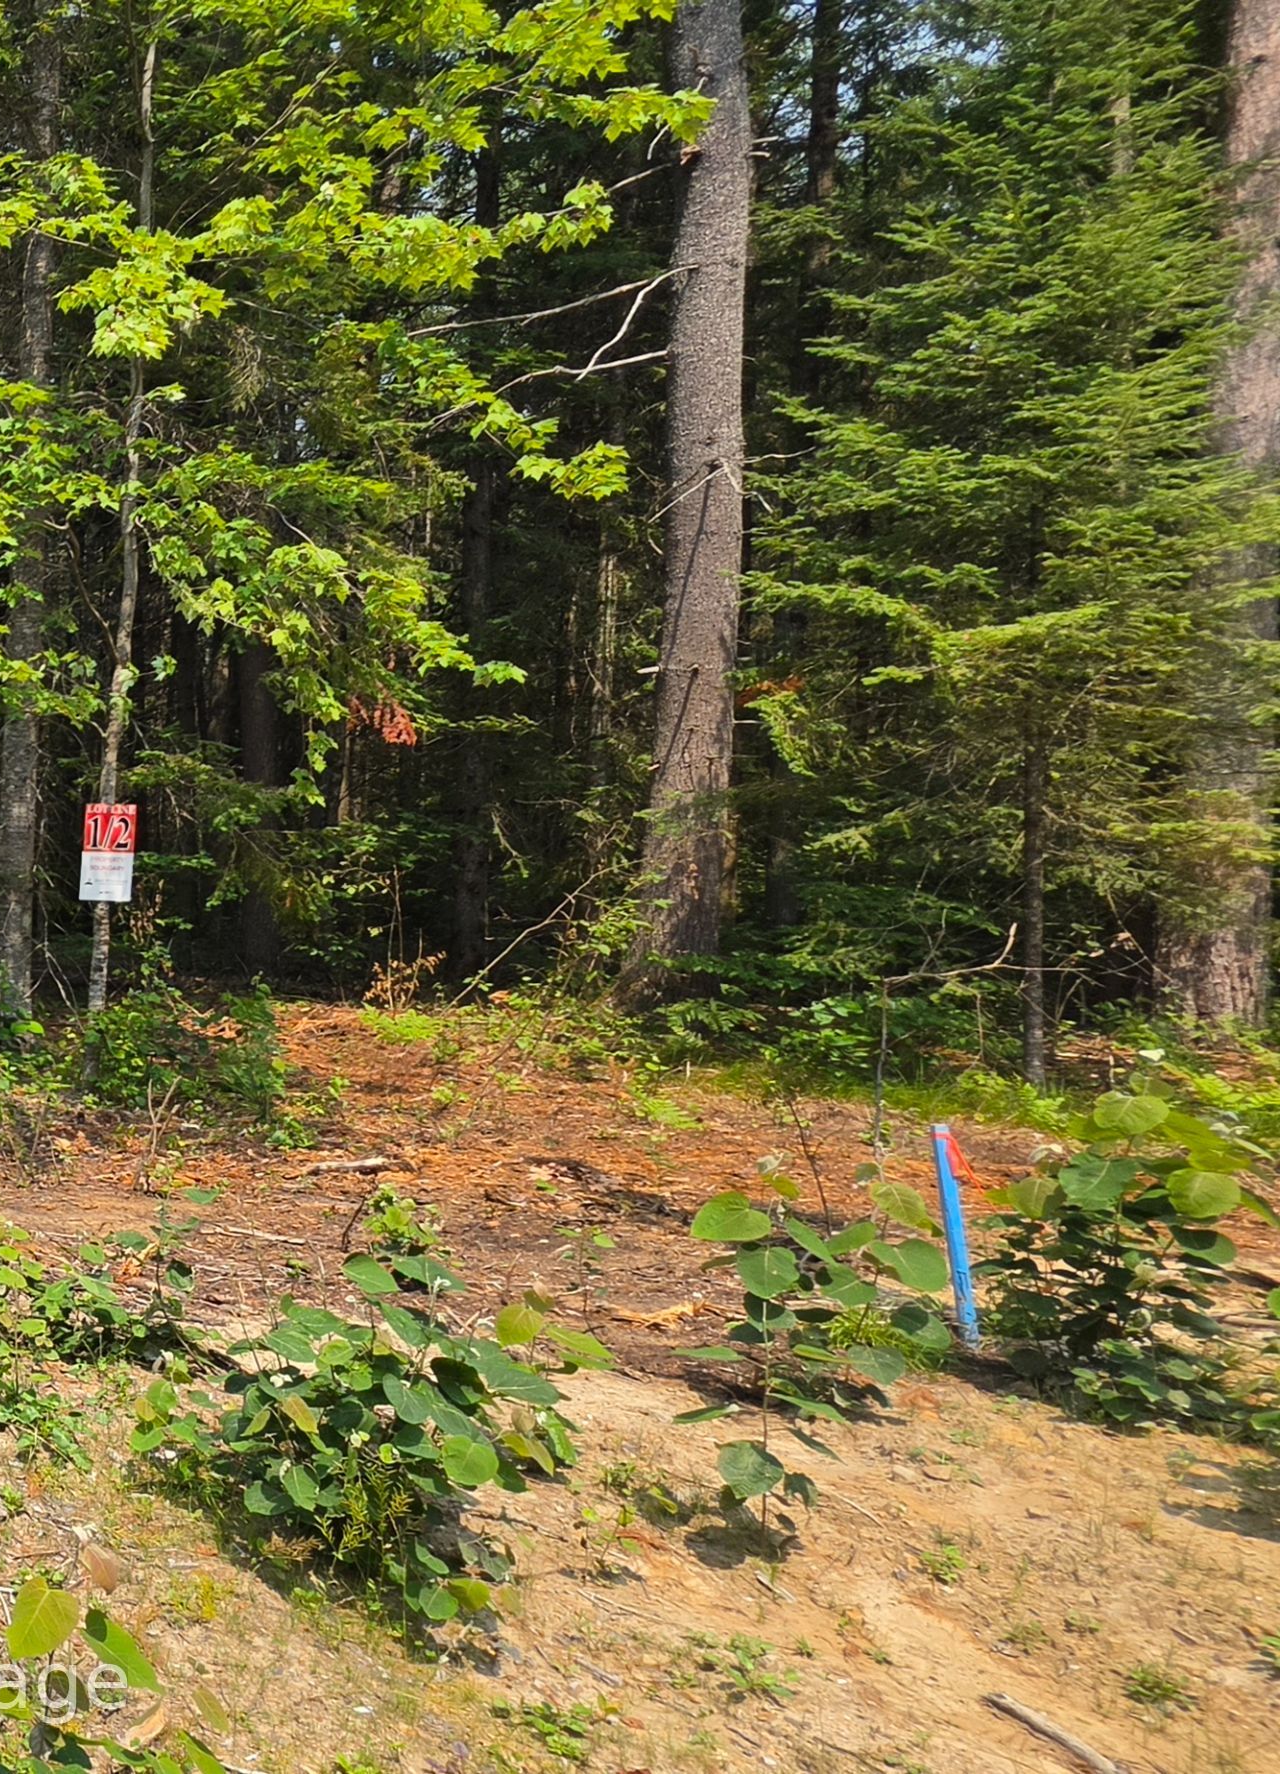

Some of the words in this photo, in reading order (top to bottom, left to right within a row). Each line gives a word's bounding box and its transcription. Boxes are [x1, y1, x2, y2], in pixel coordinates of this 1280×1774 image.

[87, 804, 108, 813] LOT
[111, 805, 137, 815] LINE
[86, 815, 131, 851] 1/2
